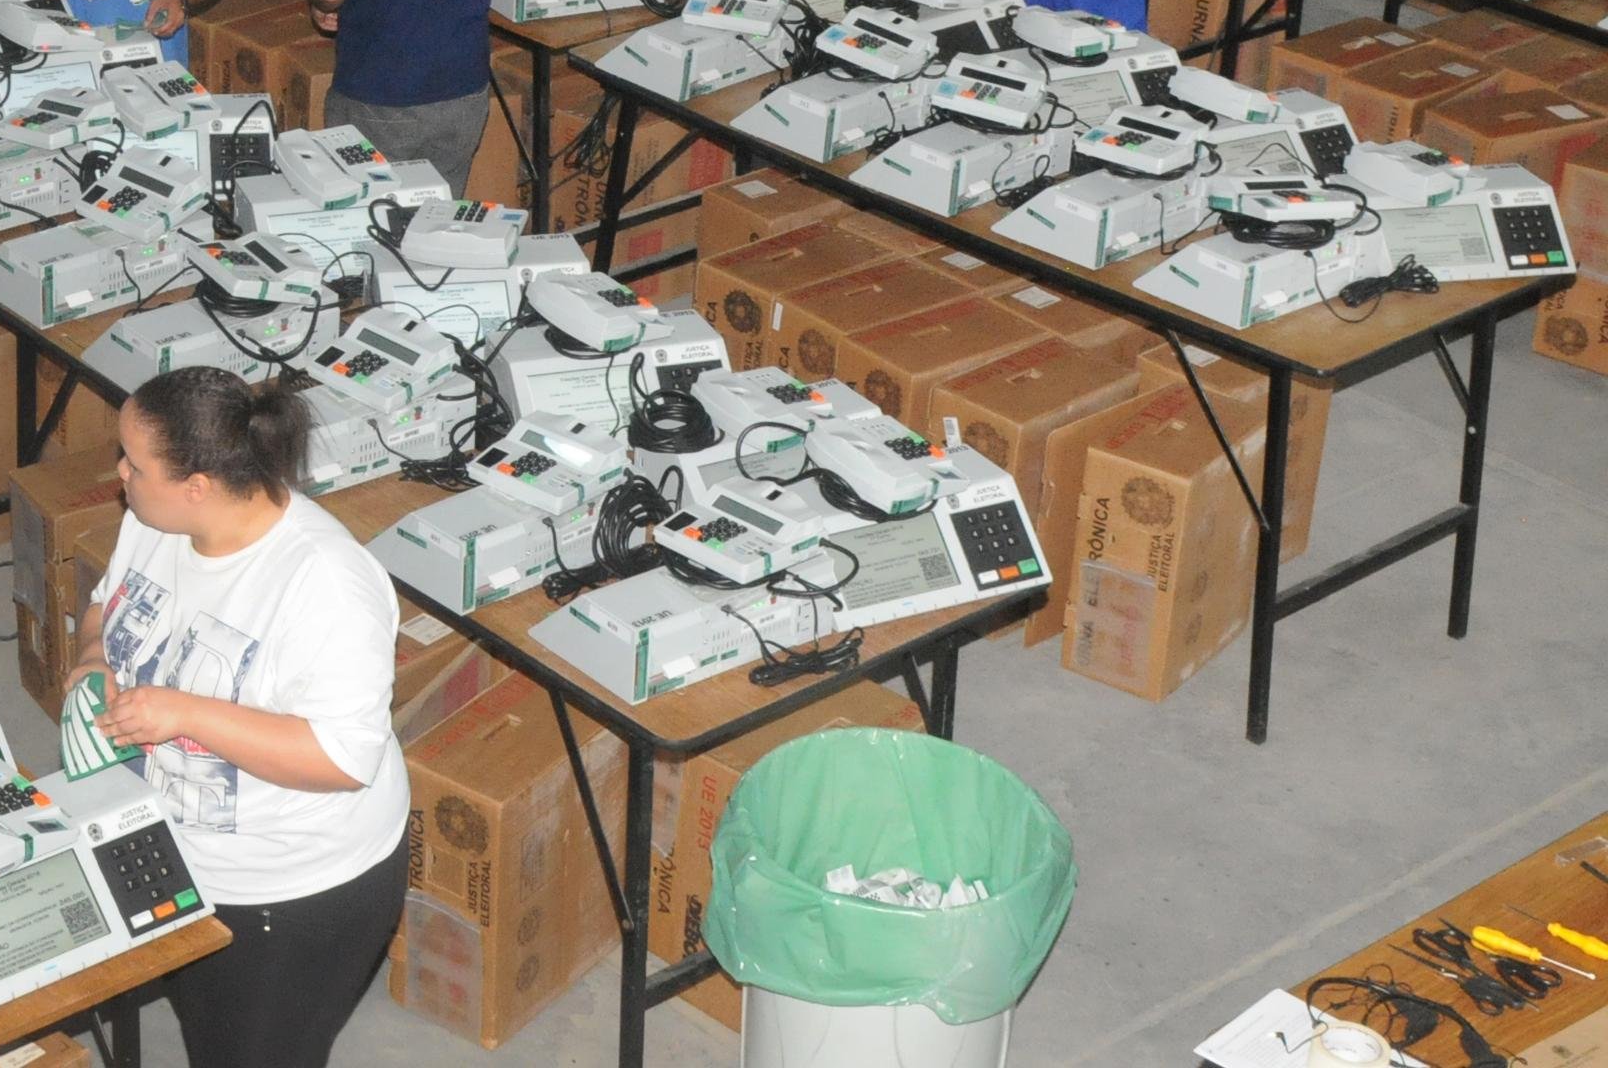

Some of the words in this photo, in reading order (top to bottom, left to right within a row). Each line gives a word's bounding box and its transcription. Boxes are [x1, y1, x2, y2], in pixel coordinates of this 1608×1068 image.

[1147, 533, 1162, 579] JUSTIÇA
[1158, 531, 1175, 593] ELEITORAL
[631, 614, 655, 628] 2013
[656, 610, 675, 621] UE
[702, 775, 718, 805] UE
[117, 811, 157, 831] ELEITORAL
[120, 804, 150, 821] JUSTIÇA
[696, 807, 716, 852] 2013
[466, 861, 480, 915] JUSTIÇA
[480, 859, 492, 929] ELEITORAL
